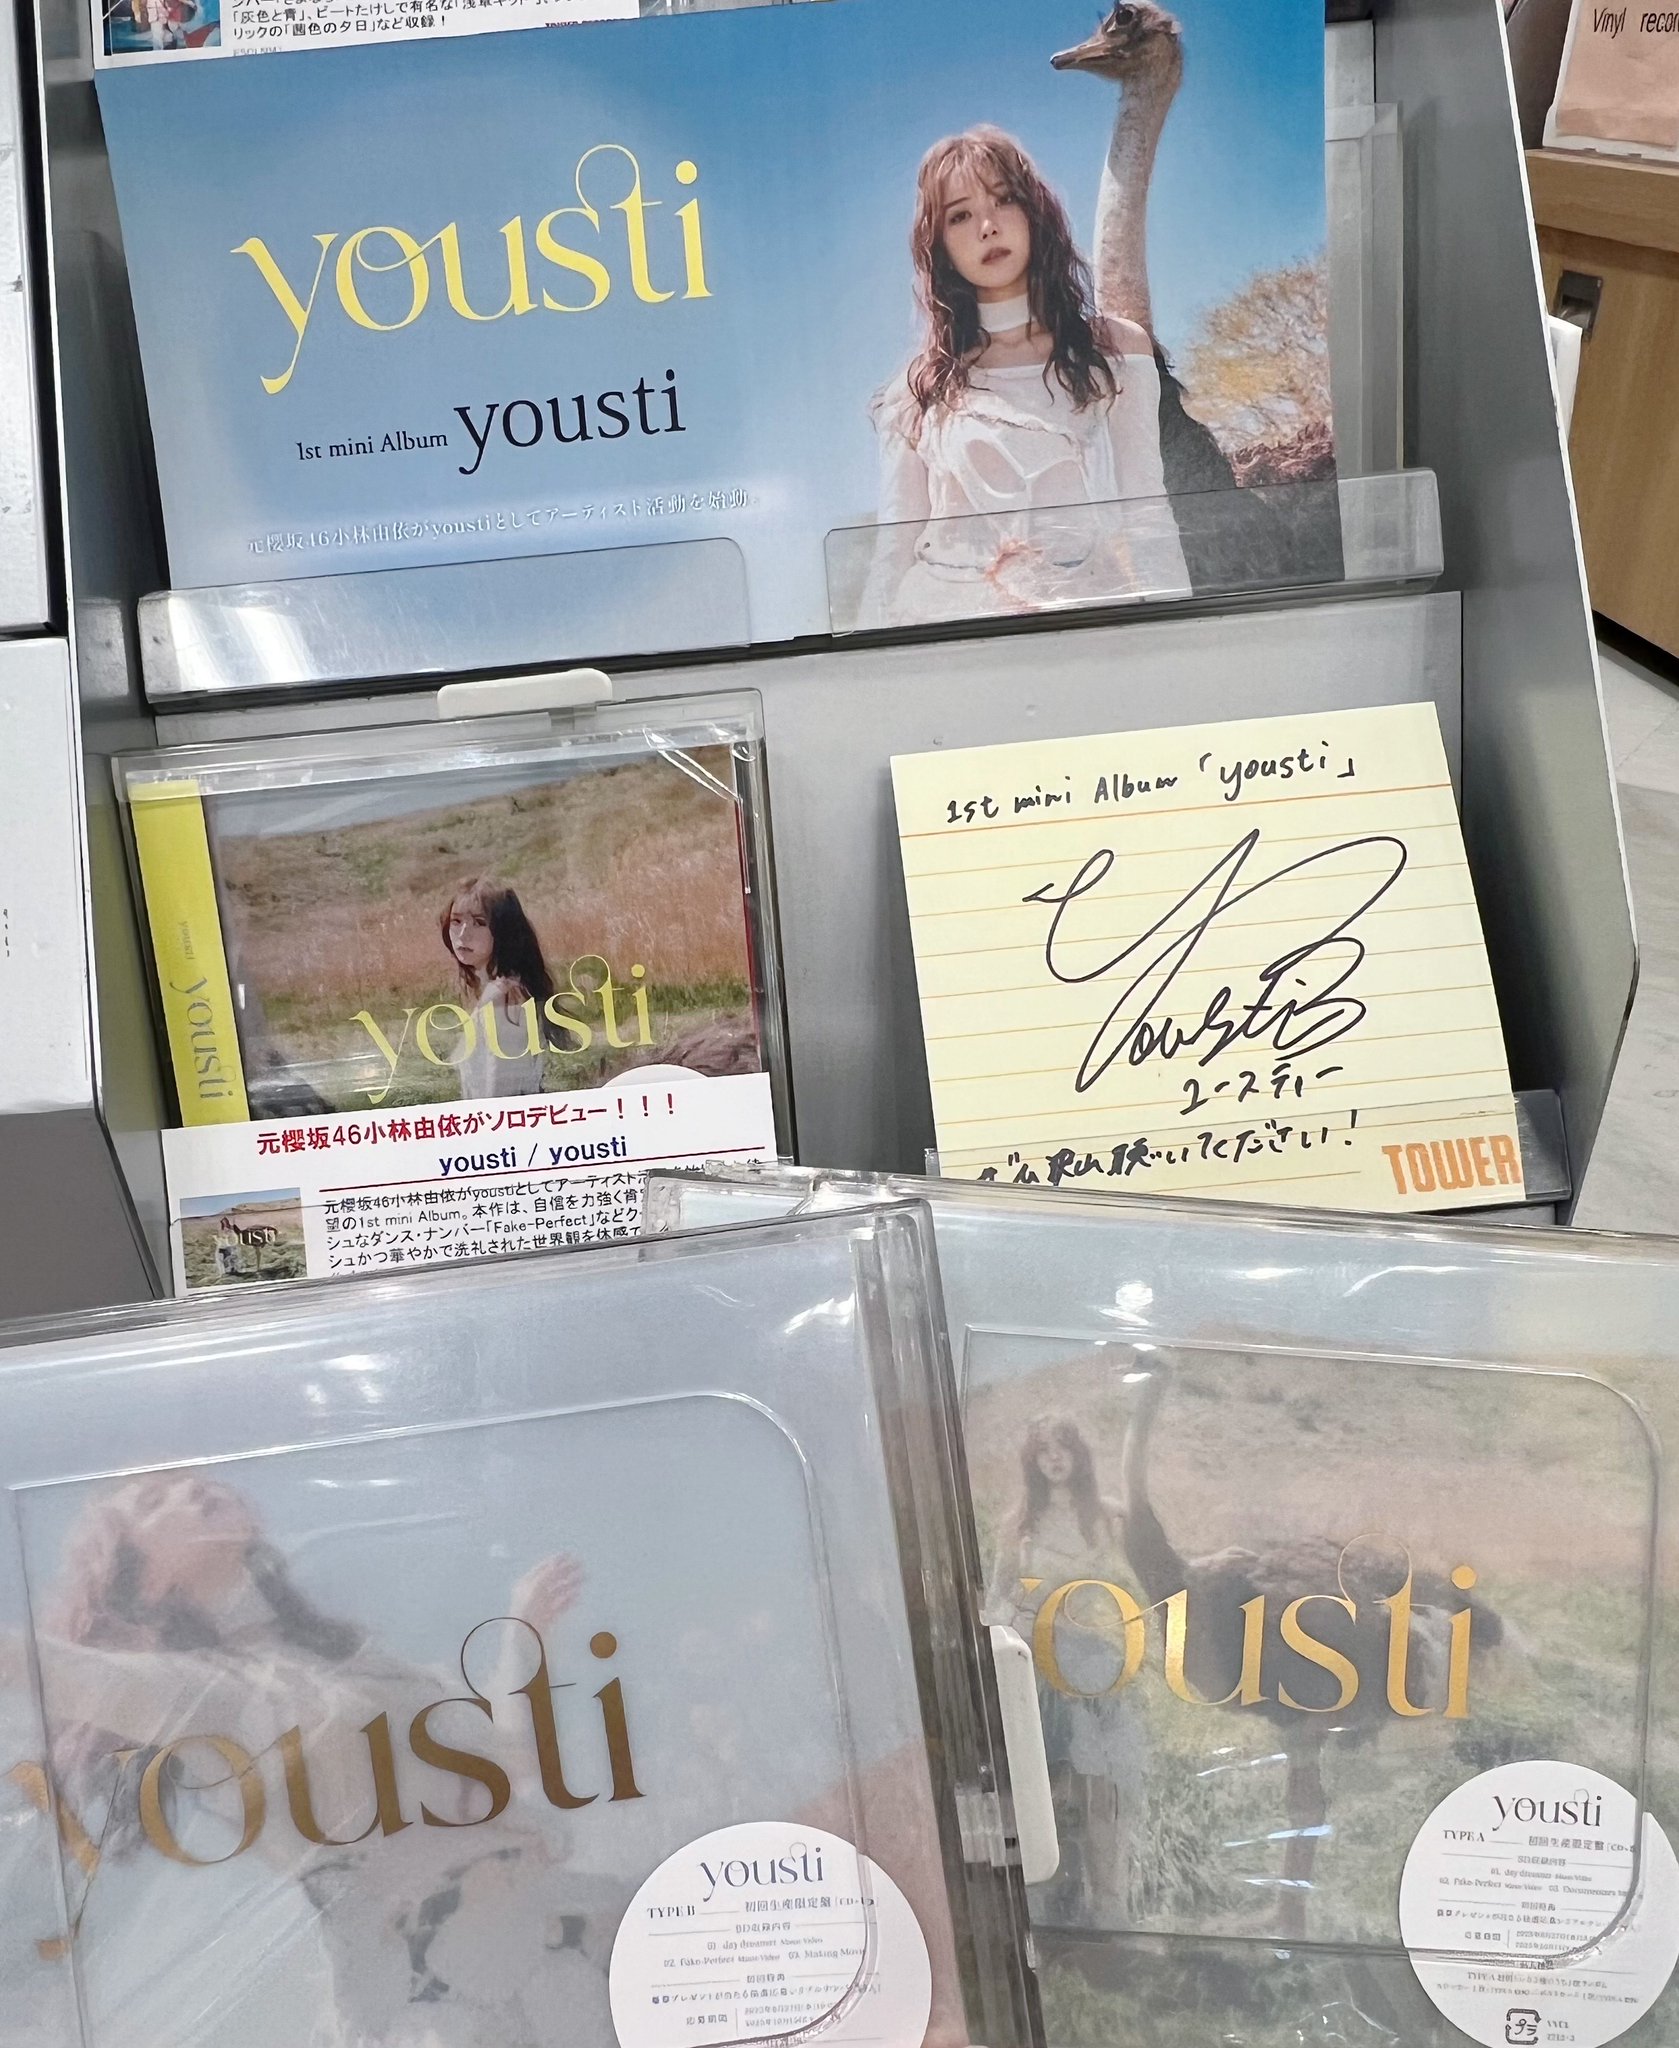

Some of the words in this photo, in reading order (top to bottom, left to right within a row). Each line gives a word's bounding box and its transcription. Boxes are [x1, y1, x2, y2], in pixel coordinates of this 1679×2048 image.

[1593, 7, 1627, 39] Vinyl
[1640, 12, 1679, 33] recor
[230, 144, 714, 394] yousti
[296, 442, 322, 460] 1st
[329, 436, 374, 457] mini
[380, 431, 448, 452] Album
[453, 369, 686, 475] yousti
[947, 795, 999, 824] 1st
[1014, 775, 1071, 813] mini
[1094, 773, 1178, 804] Album
[169, 976, 237, 1101] yousti
[349, 954, 657, 1105] yousti
[439, 1146, 517, 1177] yousti
[527, 1143, 538, 1167] /
[549, 1136, 627, 1166] yousti
[1382, 1134, 1522, 1194] TOWER
[418, 1188, 646, 1223] Album。本作は、自信を力強く肯
[1020, 1533, 1471, 1719] ousti
[1443, 1829, 1475, 1841] TYPE
[1492, 1788, 1602, 1832] yousti
[700, 1842, 824, 1902] yousti
[647, 1905, 684, 1919] TYPE
